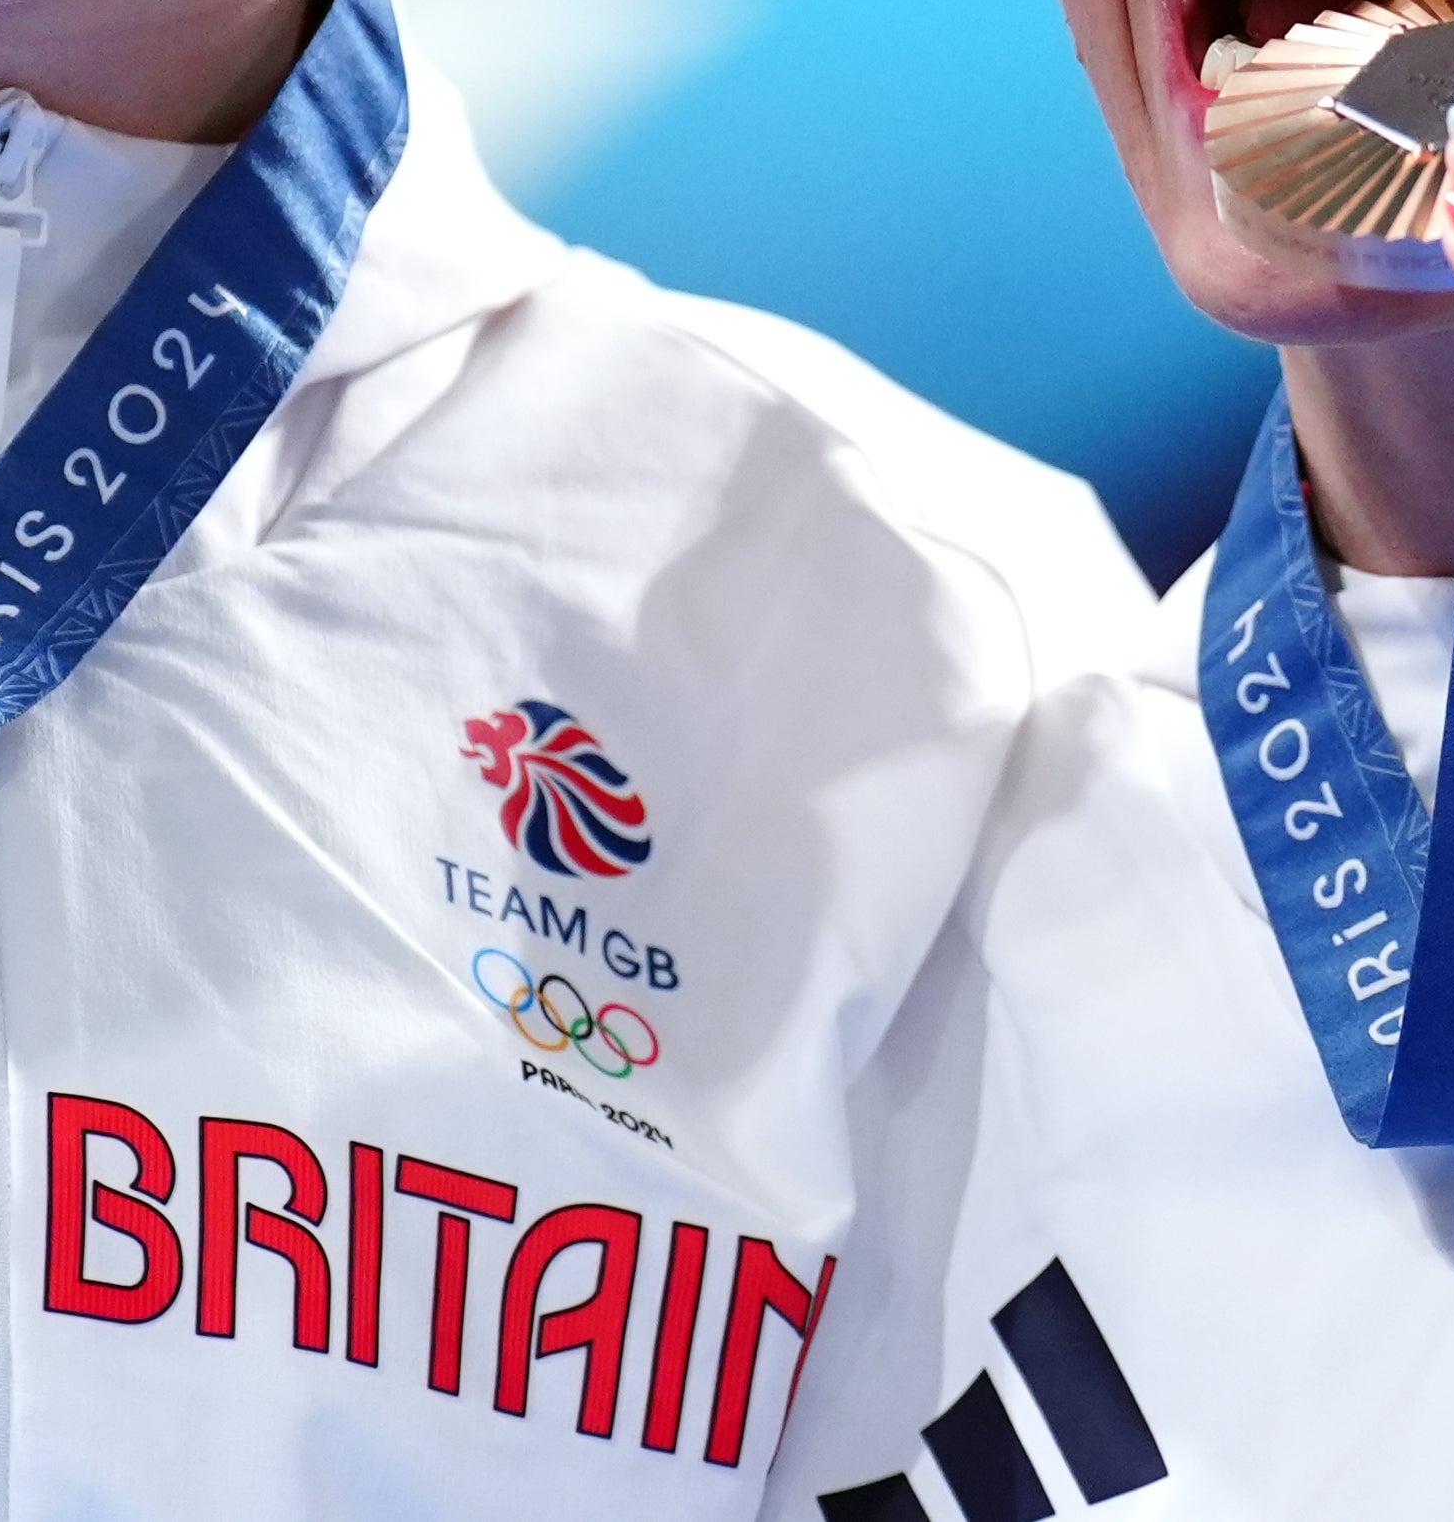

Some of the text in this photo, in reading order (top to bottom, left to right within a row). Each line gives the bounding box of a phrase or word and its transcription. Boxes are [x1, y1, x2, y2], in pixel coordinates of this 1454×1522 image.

[62, 282, 248, 506] 2024
[1226, 598, 1344, 842] 2024
[435, 855, 679, 992] TEAM GB
